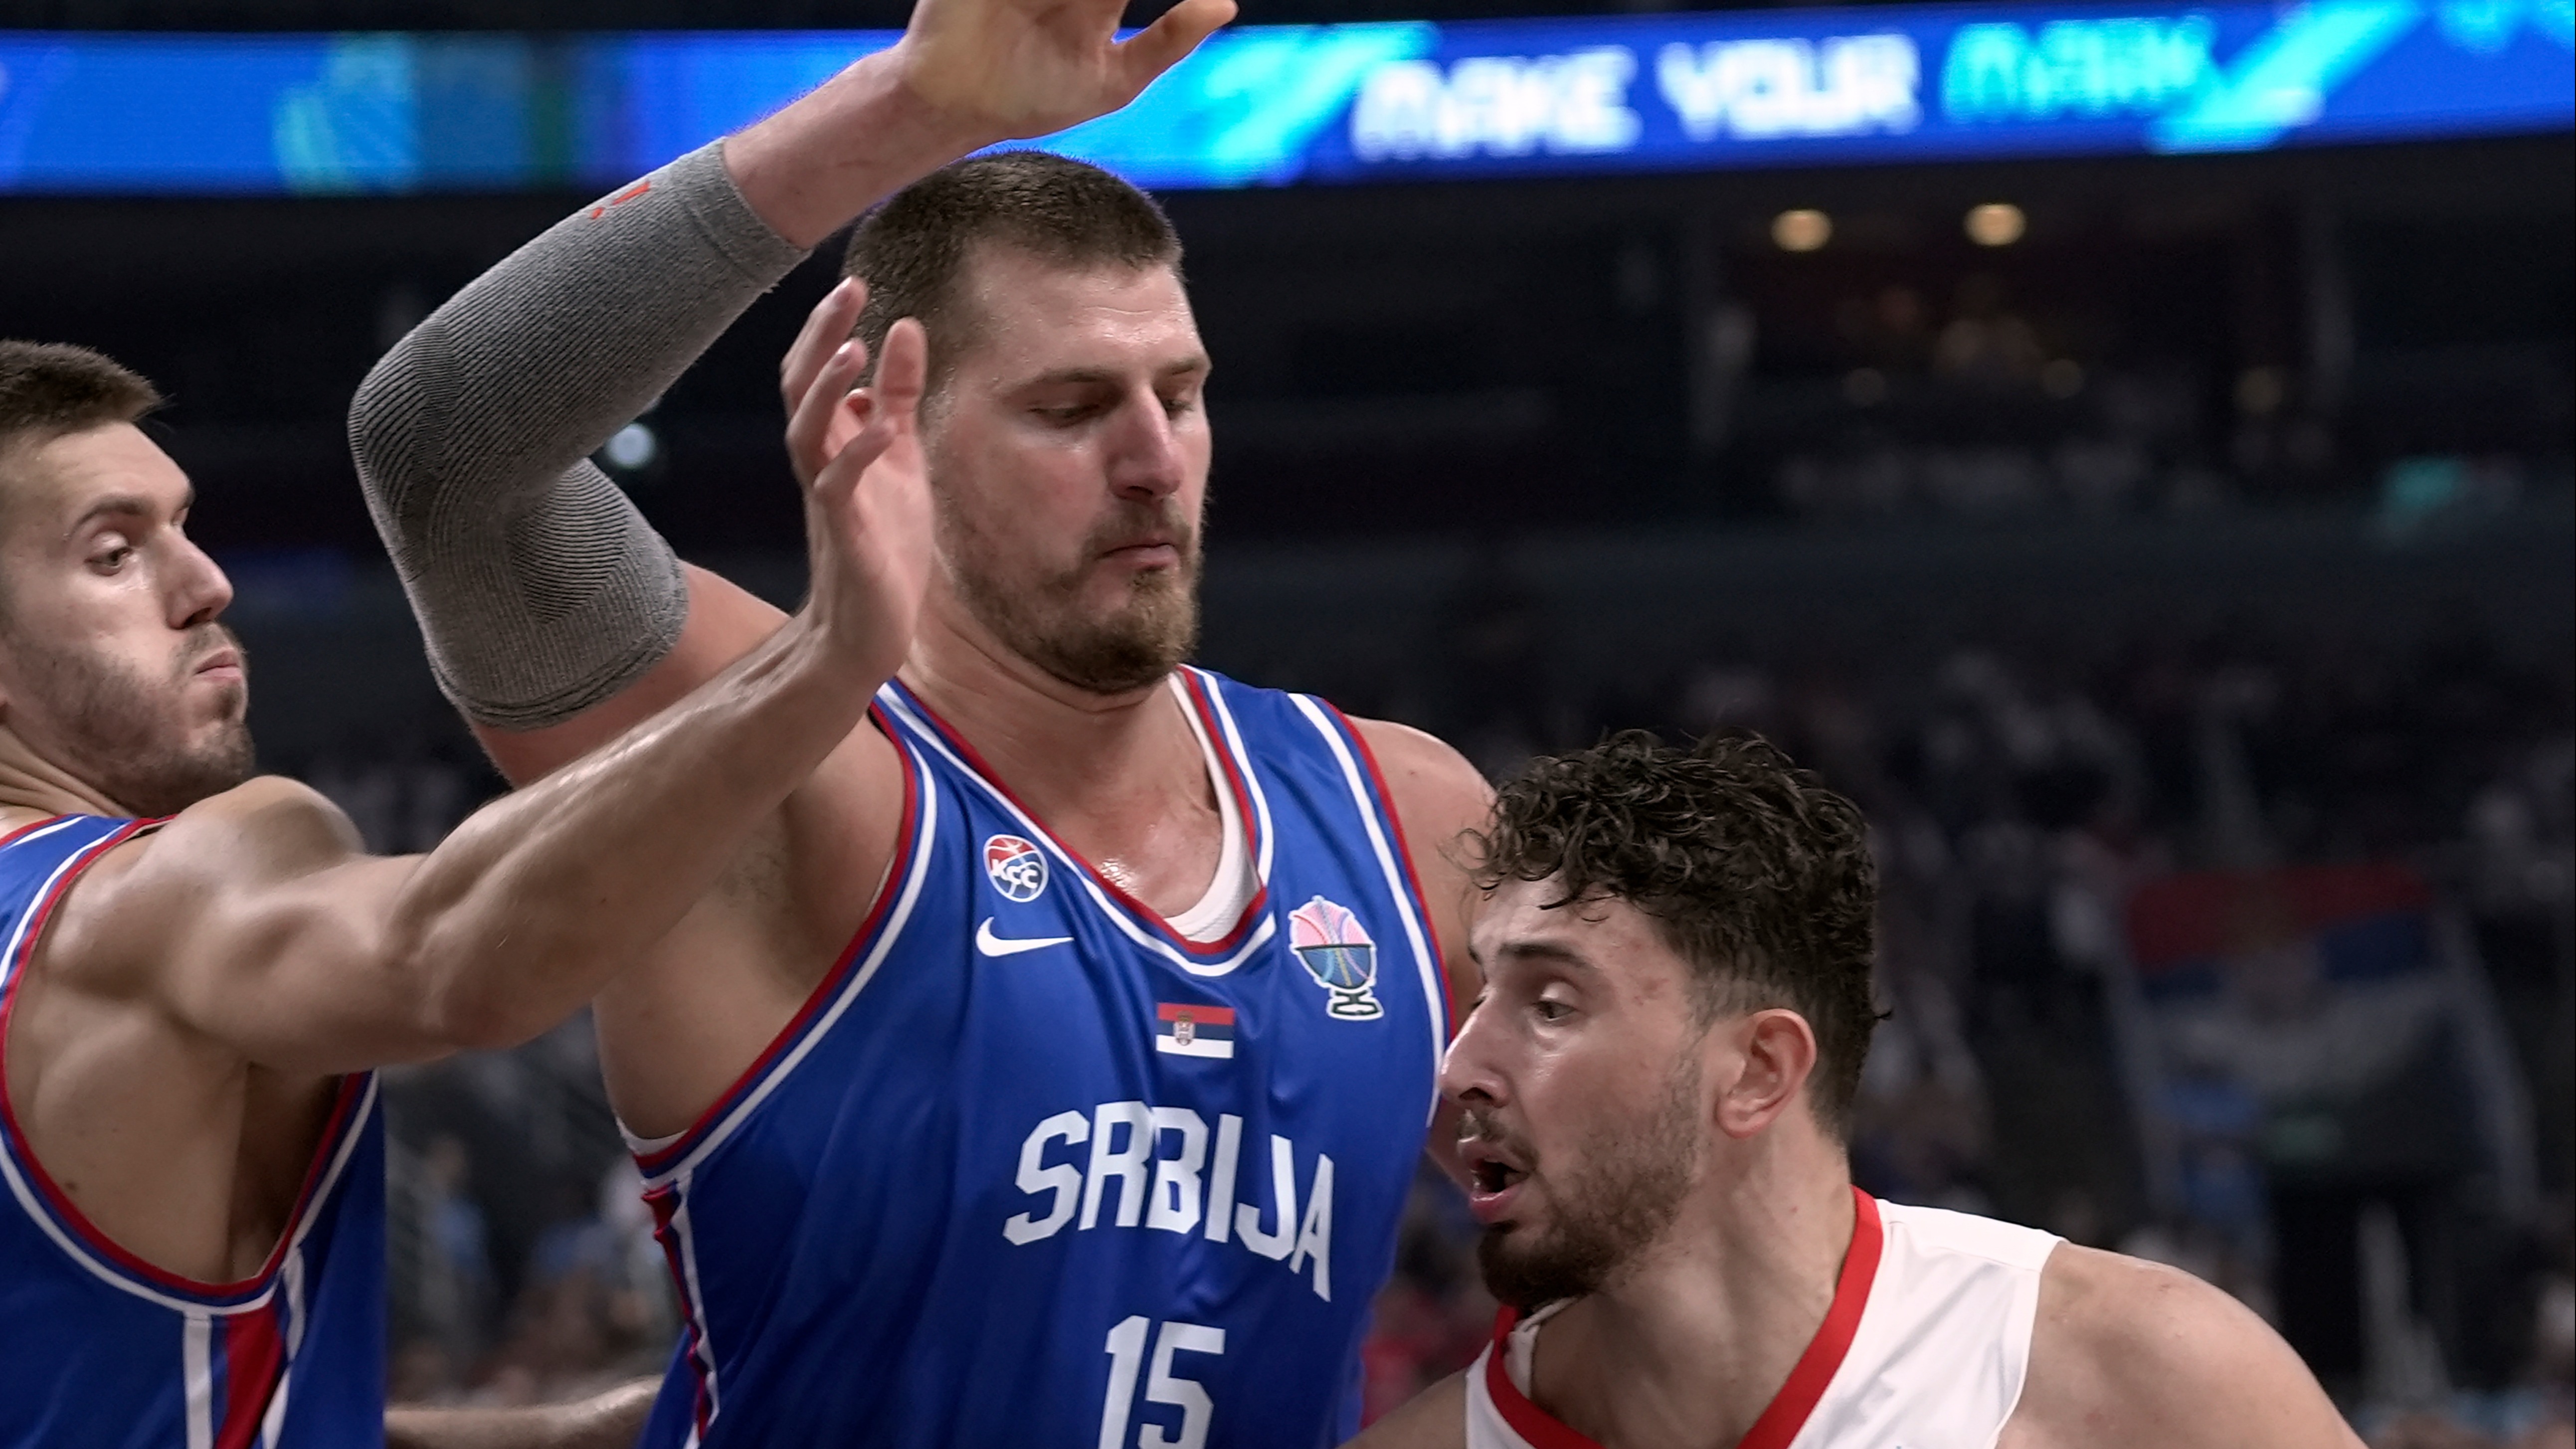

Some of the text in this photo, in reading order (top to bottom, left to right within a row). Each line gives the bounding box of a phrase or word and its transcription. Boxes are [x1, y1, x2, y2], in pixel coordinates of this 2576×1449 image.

[1352, 48, 1640, 159] MAKE
[1658, 35, 1920, 141] YOUR
[1003, 1100, 1334, 1302] SRBIJA
[1099, 1315, 1226, 1449] 15
